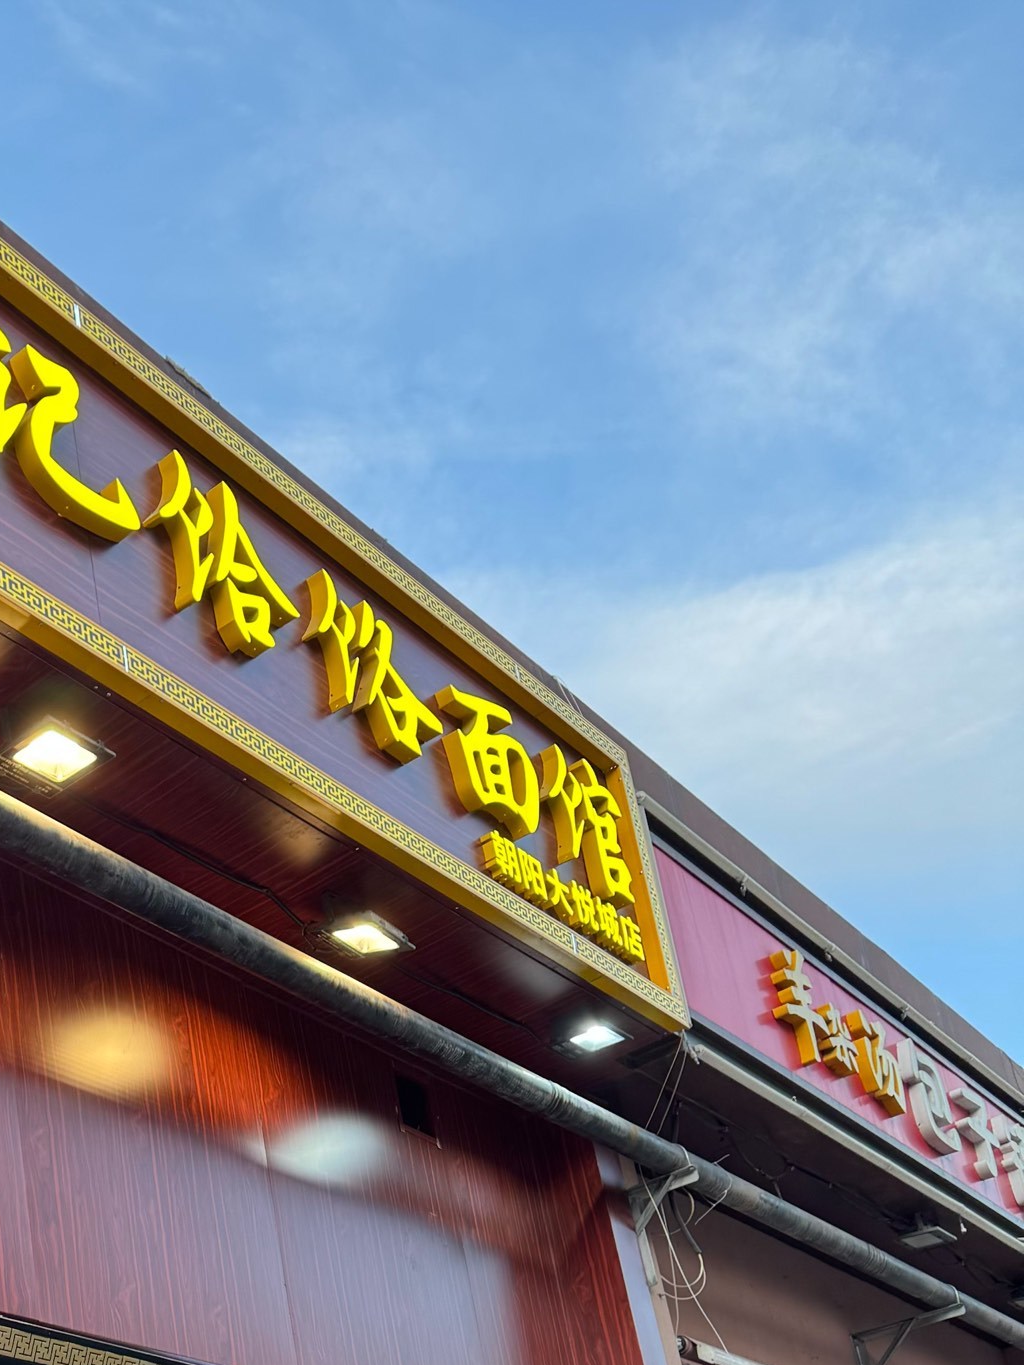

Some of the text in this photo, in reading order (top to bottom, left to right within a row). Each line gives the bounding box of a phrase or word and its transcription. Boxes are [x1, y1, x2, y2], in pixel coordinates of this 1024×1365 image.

[480, 829, 646, 962] 朝阳大悦城店
